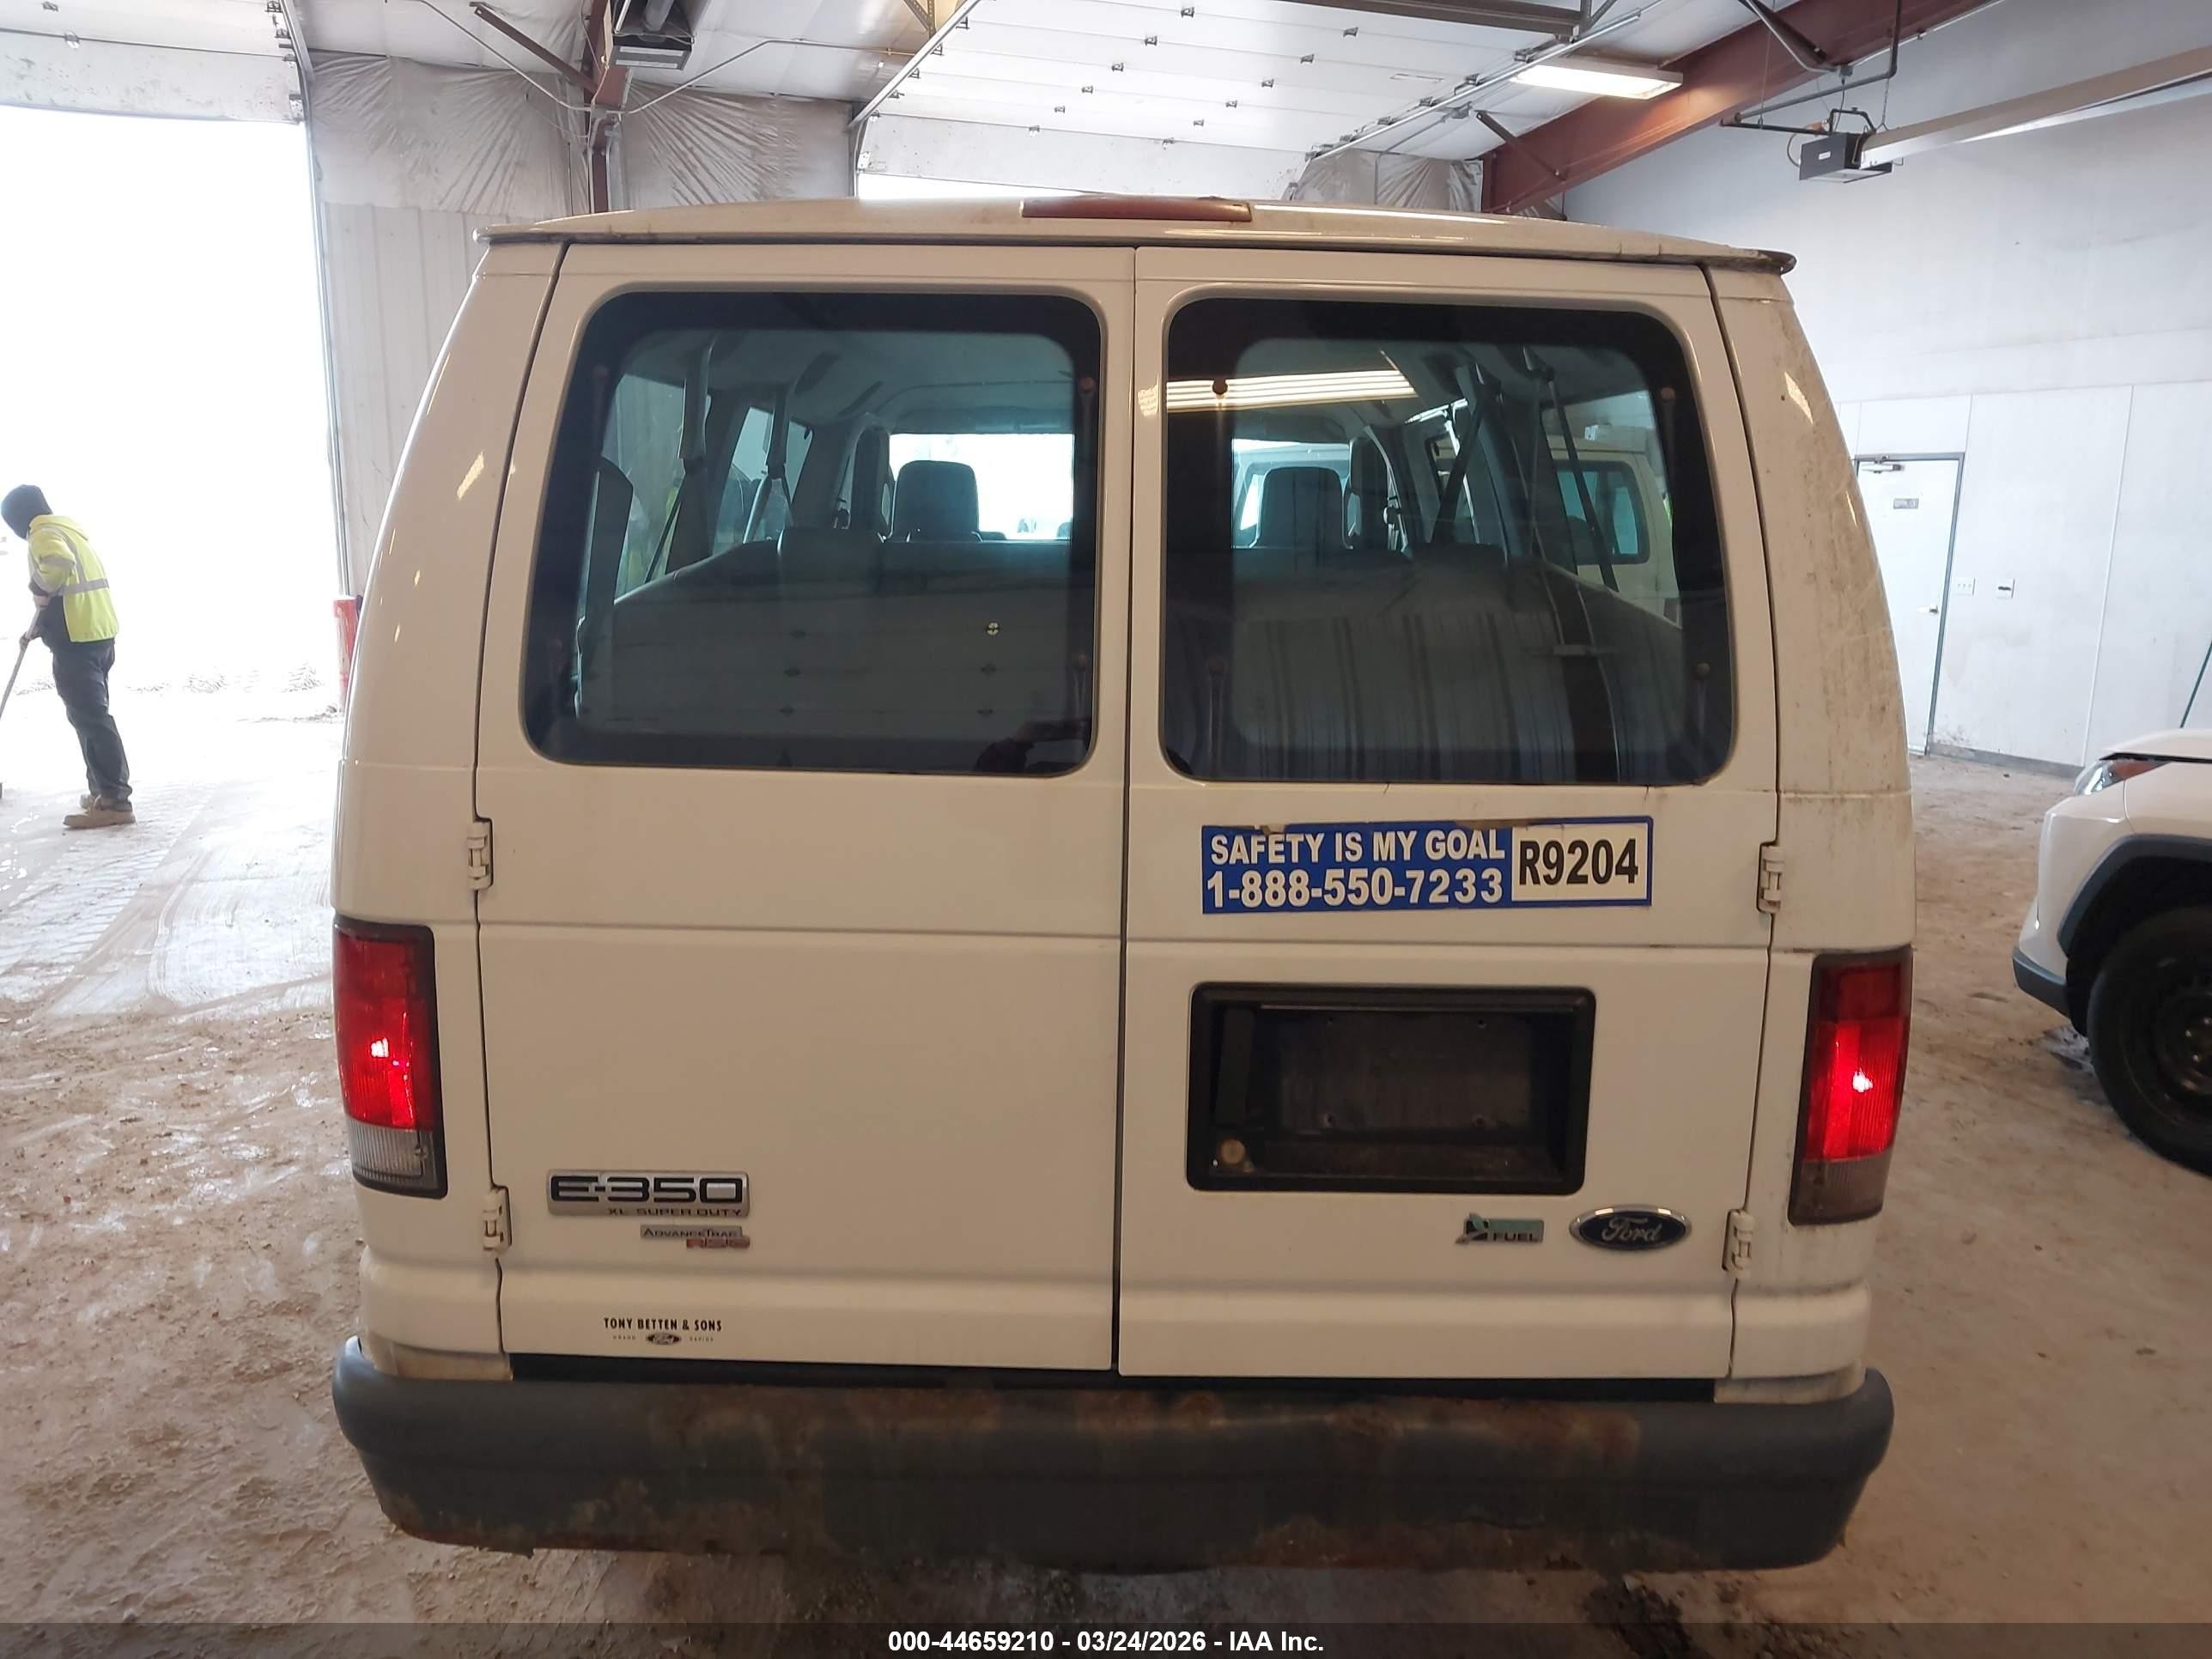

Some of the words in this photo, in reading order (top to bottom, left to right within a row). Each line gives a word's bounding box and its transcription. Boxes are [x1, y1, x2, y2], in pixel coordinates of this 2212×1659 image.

[1211, 833, 1325, 865] SAFETY
[1335, 831, 1364, 863] IS
[1373, 830, 1418, 861] MY
[1425, 829, 1505, 860] GOAL
[1519, 838, 1638, 885] R9204
[1206, 867, 1504, 908] 1-888-550-7233
[550, 1176, 744, 1203] E-350
[608, 1207, 626, 1216] XL
[636, 1207, 691, 1217] SUPER
[696, 1208, 741, 1217] DUTY
[1492, 1231, 1539, 1242] FUEL
[1601, 1216, 1662, 1243] Ford
[604, 1317, 633, 1330] TONY
[637, 1318, 678, 1331] BETTEN
[683, 1319, 690, 1330] &
[694, 1320, 722, 1332] SONS
